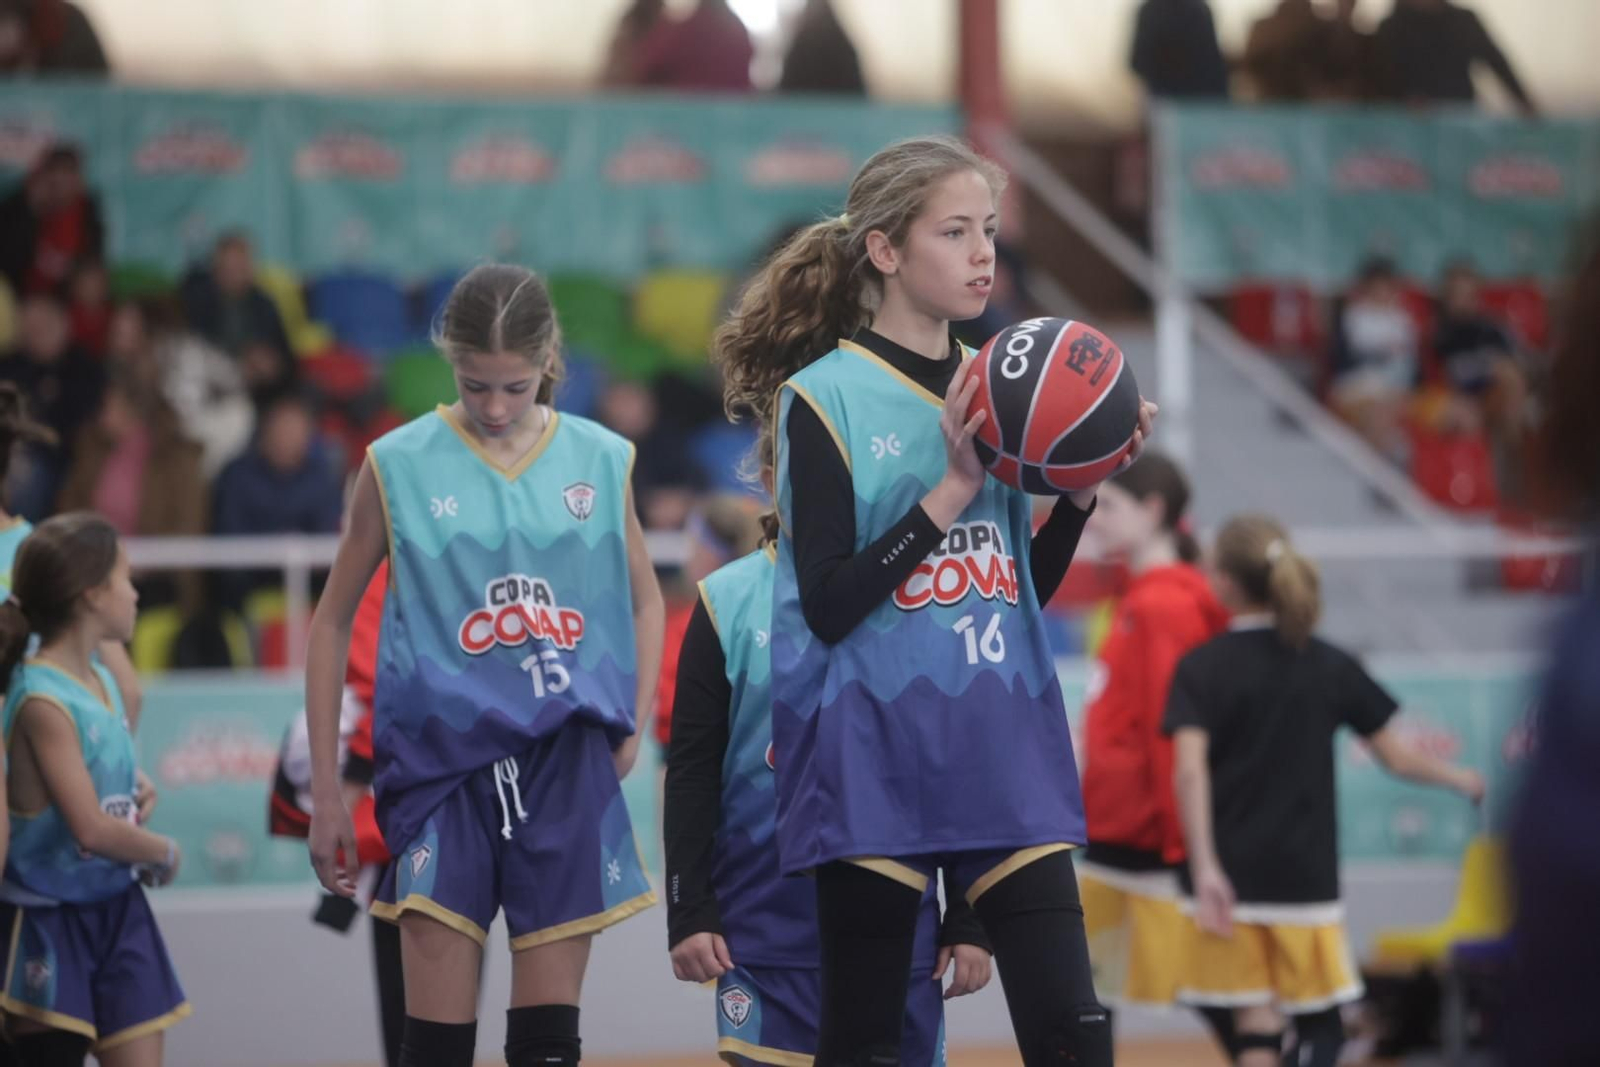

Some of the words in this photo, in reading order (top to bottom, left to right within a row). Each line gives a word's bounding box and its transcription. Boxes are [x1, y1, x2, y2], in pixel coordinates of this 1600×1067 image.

[881, 531, 916, 566] KIPSTA
[489, 577, 552, 607] COPA
[460, 603, 584, 653] COVAP
[952, 612, 1006, 665] 16
[519, 650, 571, 699] 15
